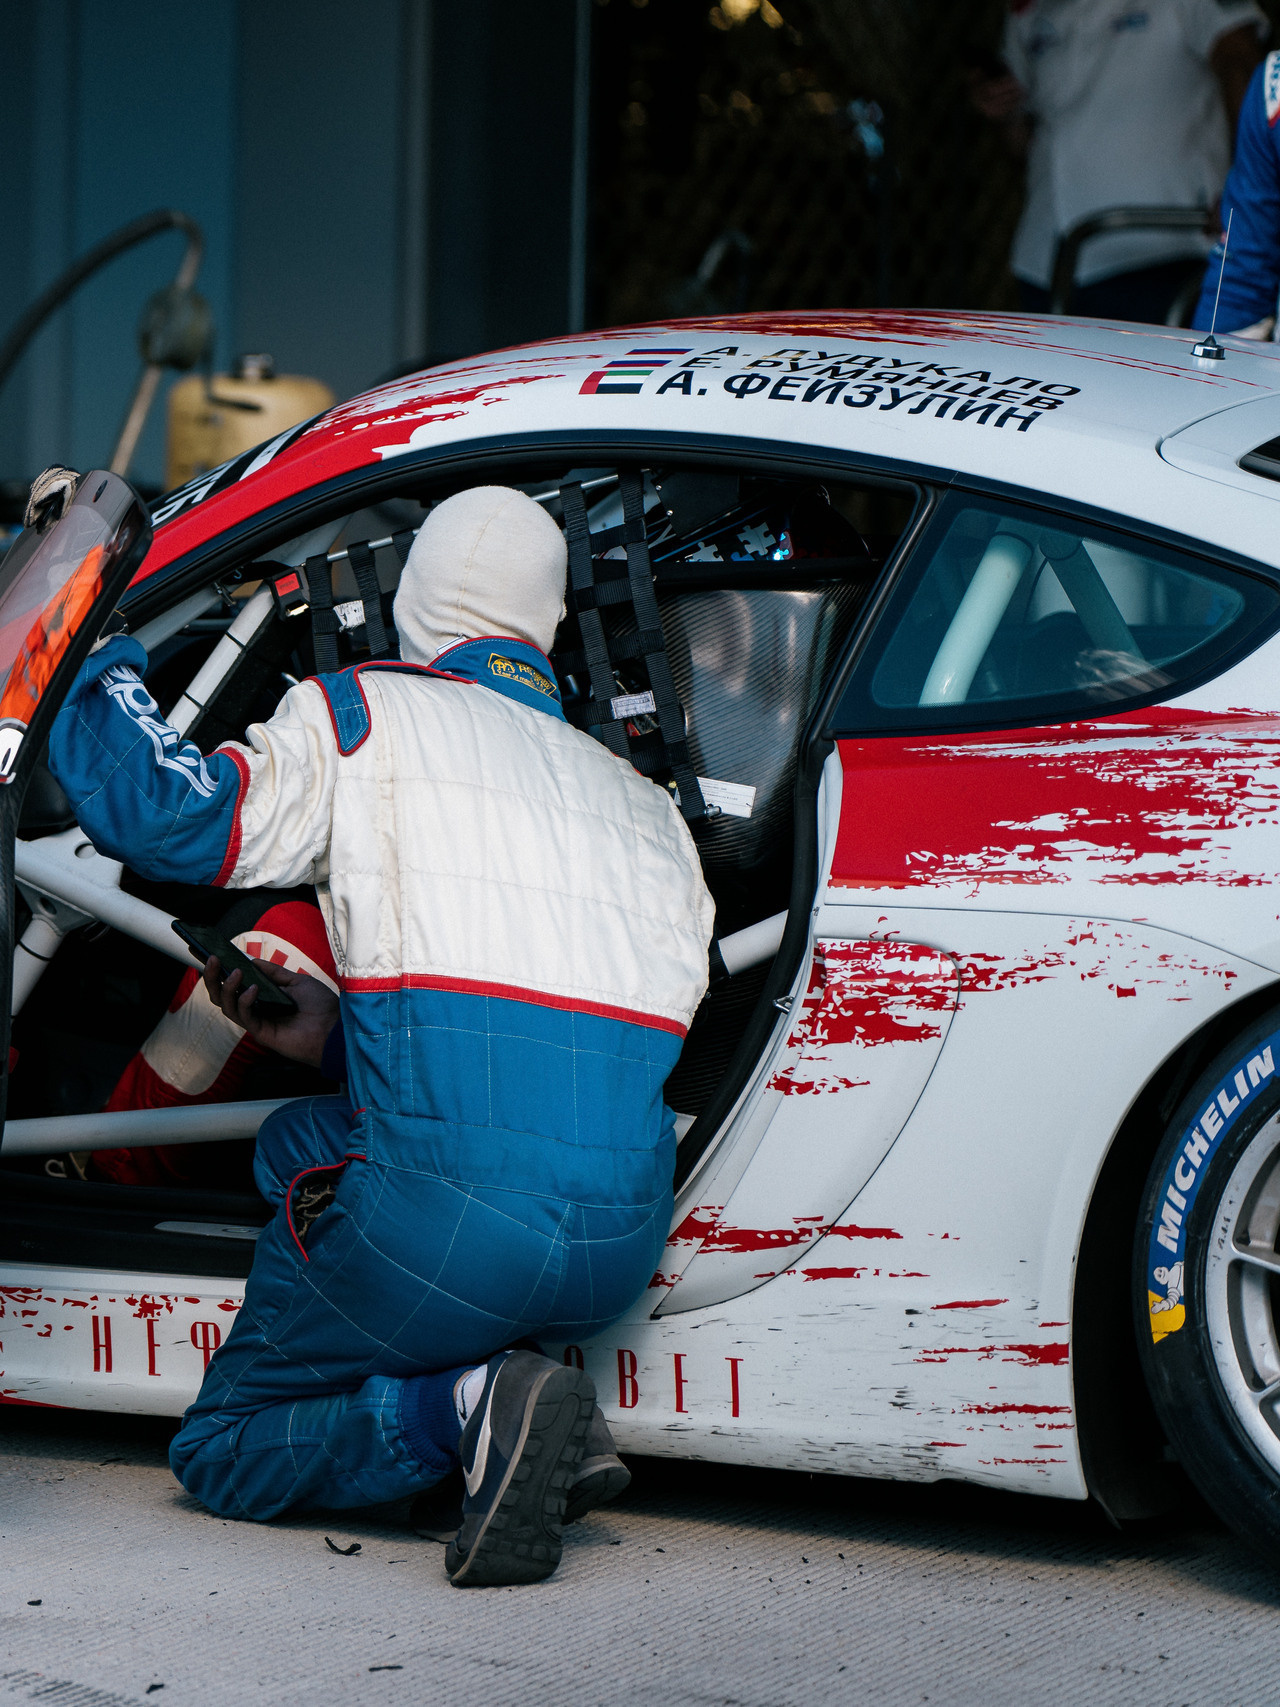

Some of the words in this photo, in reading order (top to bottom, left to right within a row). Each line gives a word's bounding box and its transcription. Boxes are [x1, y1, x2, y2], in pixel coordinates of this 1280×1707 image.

[655, 370, 708, 396] А.
[741, 359, 1065, 410] РУМЯНЦЕВ
[761, 348, 1082, 397] ДУДУКАЛО
[1157, 1045, 1276, 1255] MICHELIN
